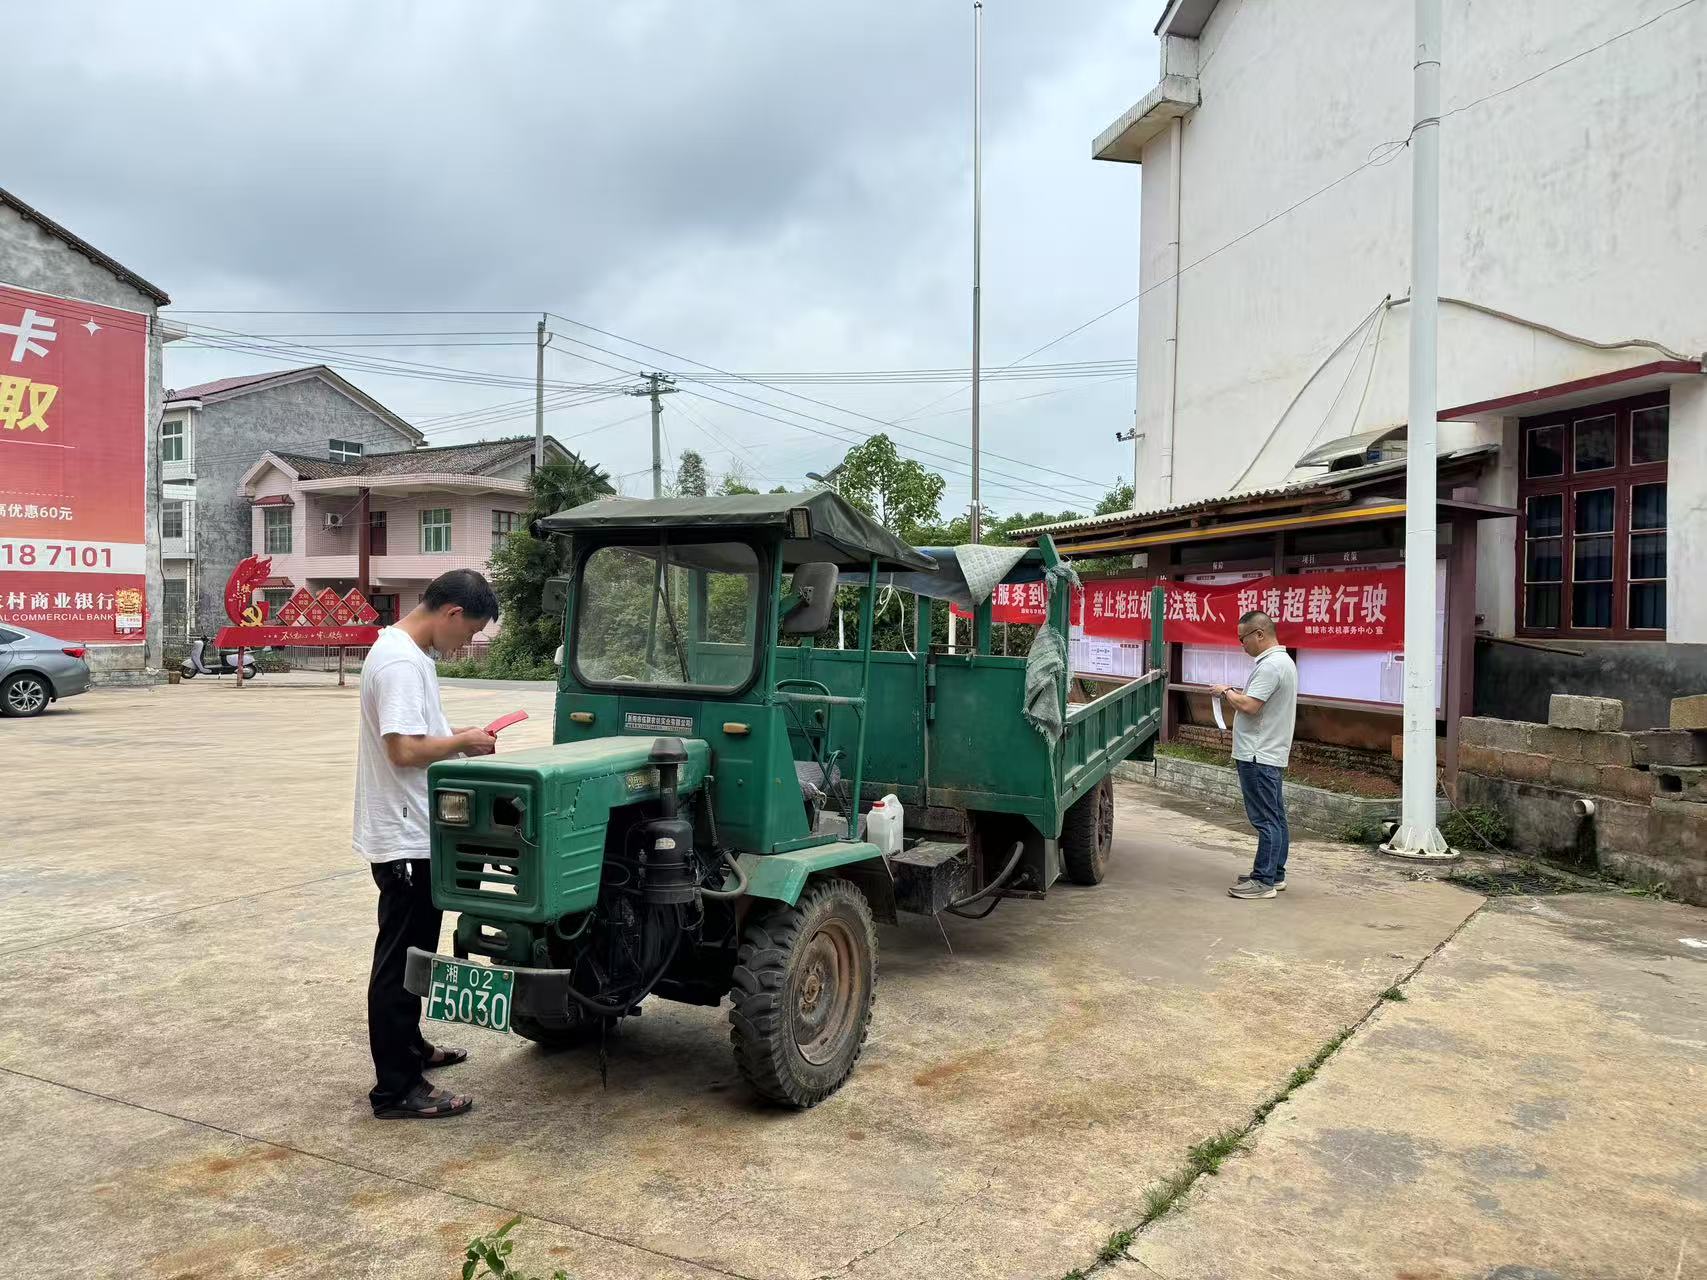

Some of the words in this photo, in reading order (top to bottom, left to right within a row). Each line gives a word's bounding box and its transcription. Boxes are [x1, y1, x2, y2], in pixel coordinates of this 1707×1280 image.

[0, 309, 57, 362] 卡
[0, 375, 58, 432] 取
[46, 545, 112, 568] 7101
[0, 591, 115, 610] 村商业银行
[1093, 583, 1387, 623] 禁止拖拉机法载人、超速超载行驶
[12, 613, 84, 621] COMMERCIAL
[86, 613, 114, 621] BANK
[445, 964, 458, 984] 湘
[469, 969, 493, 989] 02
[428, 981, 507, 1030] F5030
